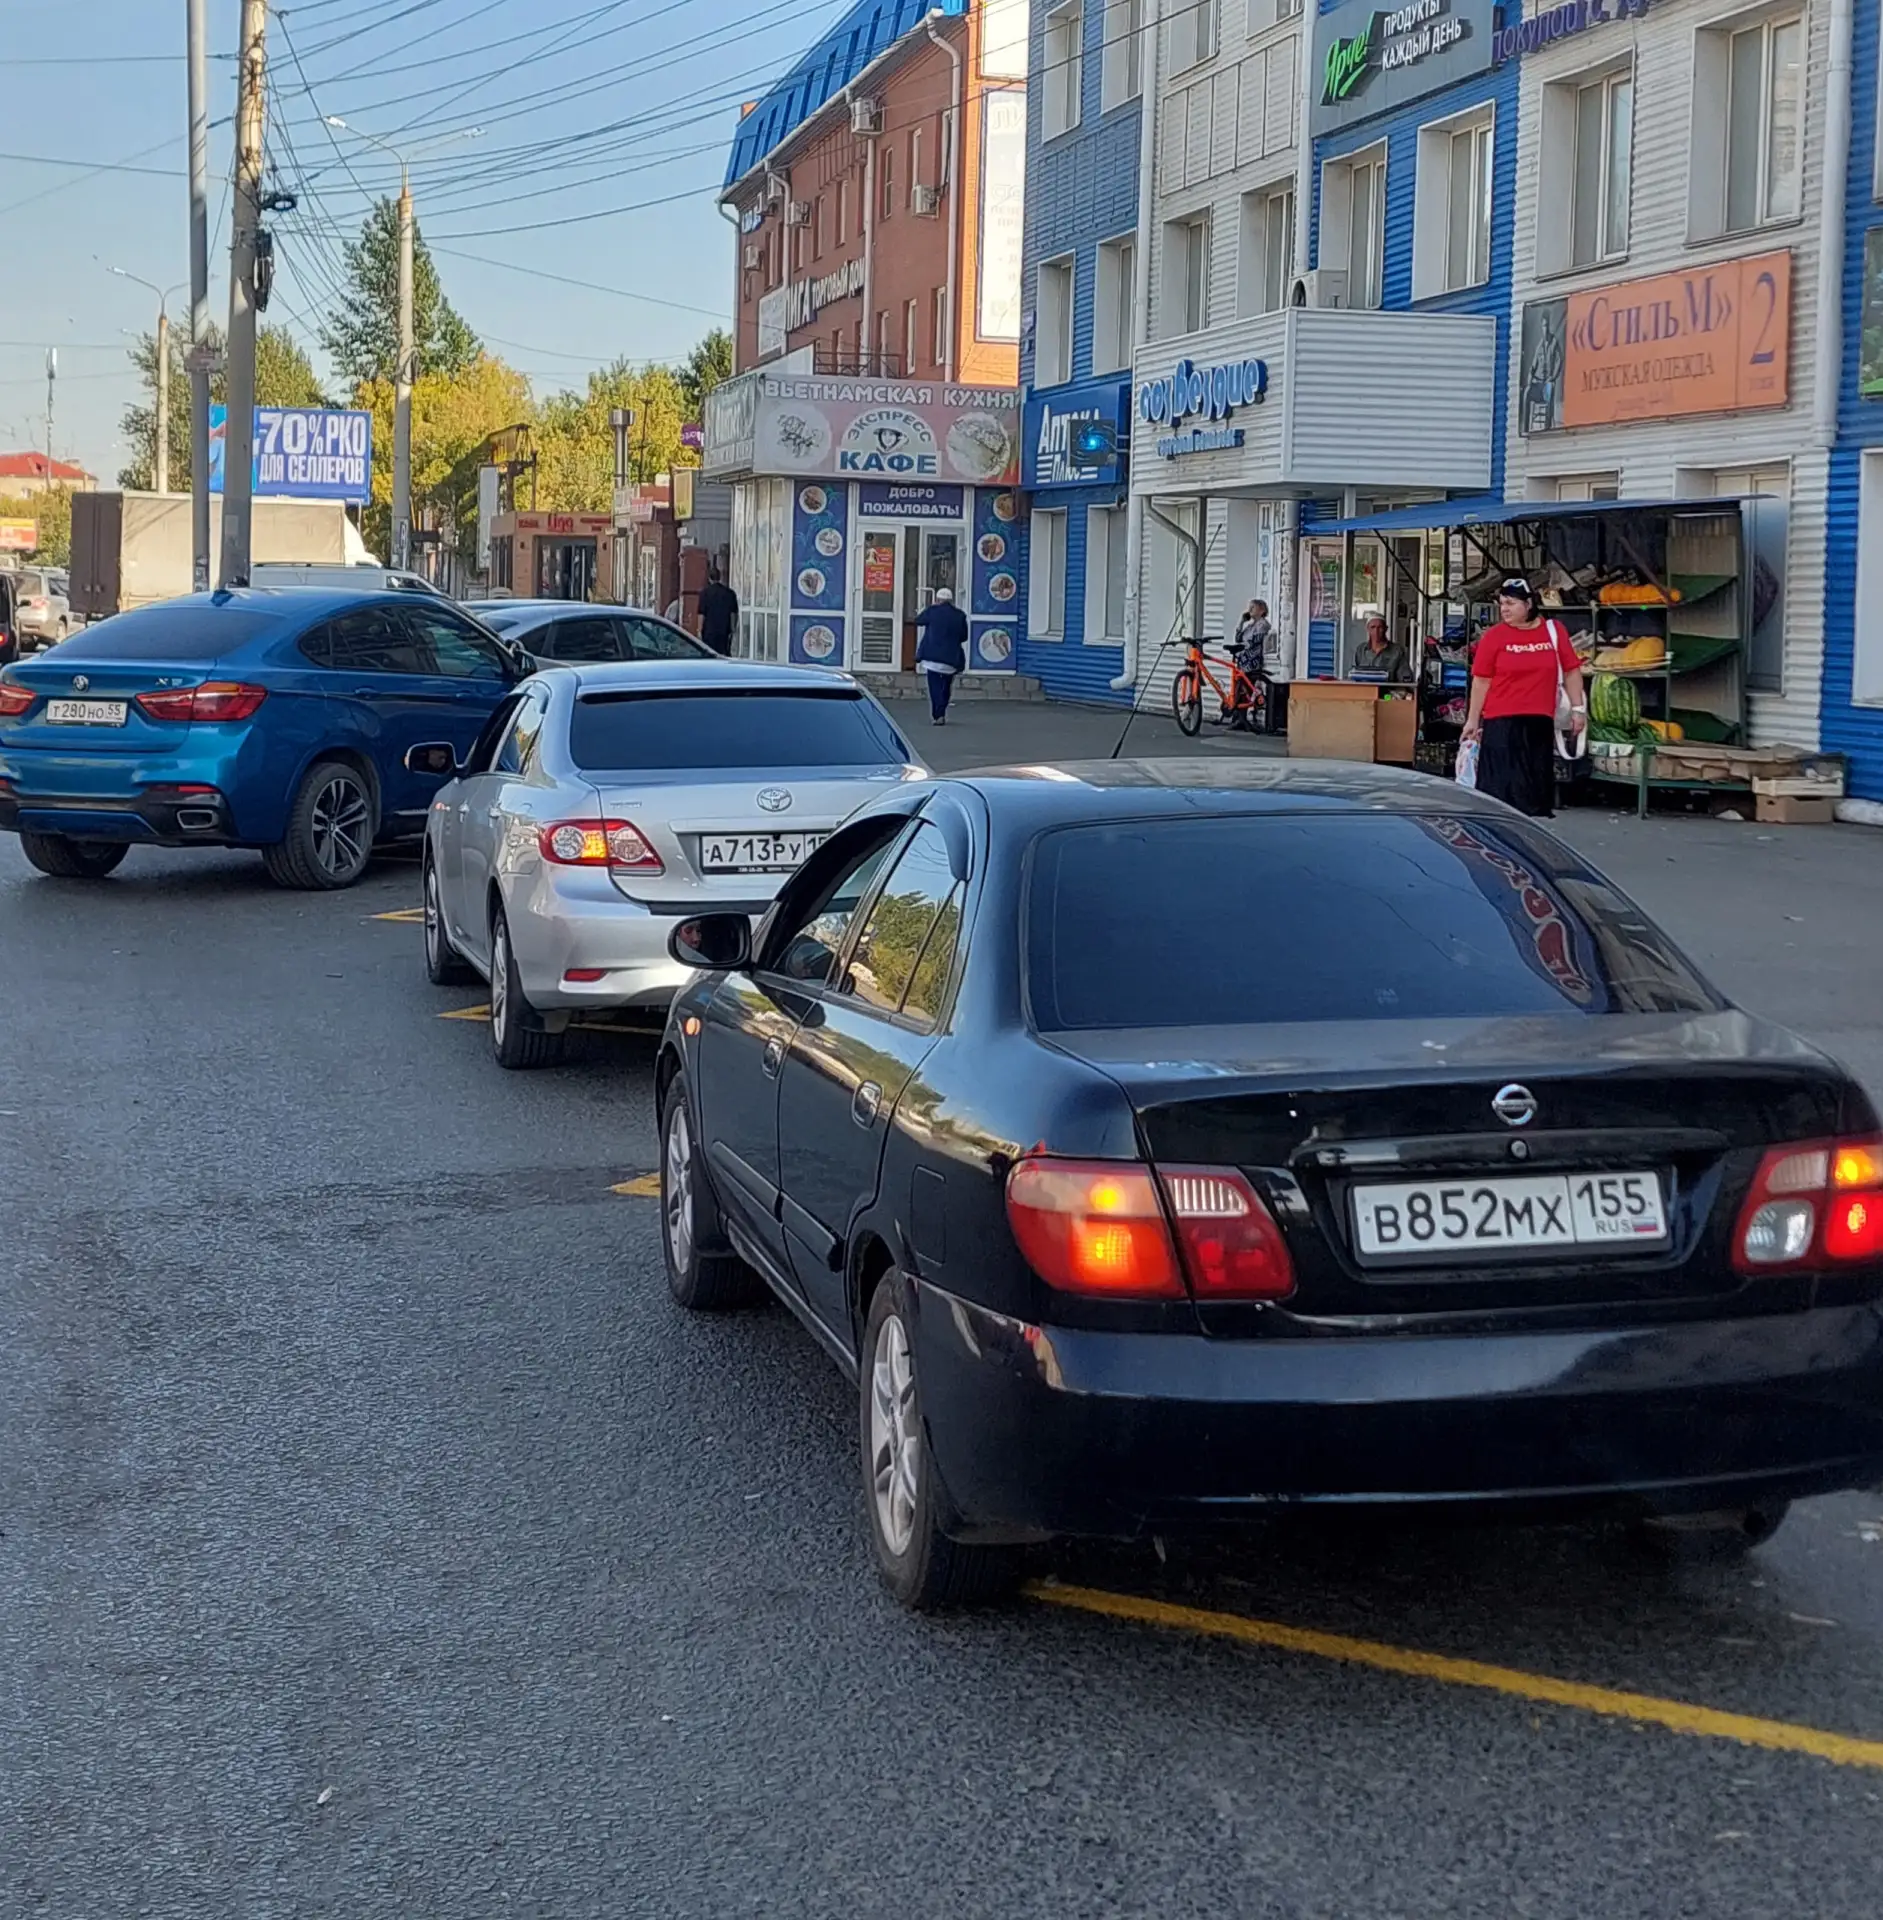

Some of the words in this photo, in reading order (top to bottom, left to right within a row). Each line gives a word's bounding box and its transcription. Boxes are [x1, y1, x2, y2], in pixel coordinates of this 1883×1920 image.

[1384, 0, 1440, 38] ПРОДУКТЫ
[1382, 25, 1430, 71] КАЖДЫЙ
[1431, 18, 1462, 54] ДЕНЬ
[1749, 272, 1776, 365] 2
[1581, 359, 1650, 393] МУЖСКАЯ
[1652, 352, 1716, 381] ОДЕЖДА
[764, 380, 933, 405] ВЬЕТНАМСКАЯ
[943, 388, 1016, 410] КУХНЯ
[325, 415, 367, 457] РКО
[847, 410, 933, 442] ЭКСПРЕСС
[259, 453, 285, 484] ДЛЯ
[287, 455, 365, 485] СЕЛЛЕРОВ
[839, 450, 938, 475] КАФЕ
[862, 502, 960, 517] ПОЖАЛОВАТЬ!
[888, 487, 936, 500] ДОБРО
[107, 703, 122, 717] 55
[709, 837, 802, 863] А713РУ
[1373, 1186, 1567, 1244] В852МХ
[1577, 1178, 1647, 1218] 155
[1595, 1219, 1631, 1235] RUS
